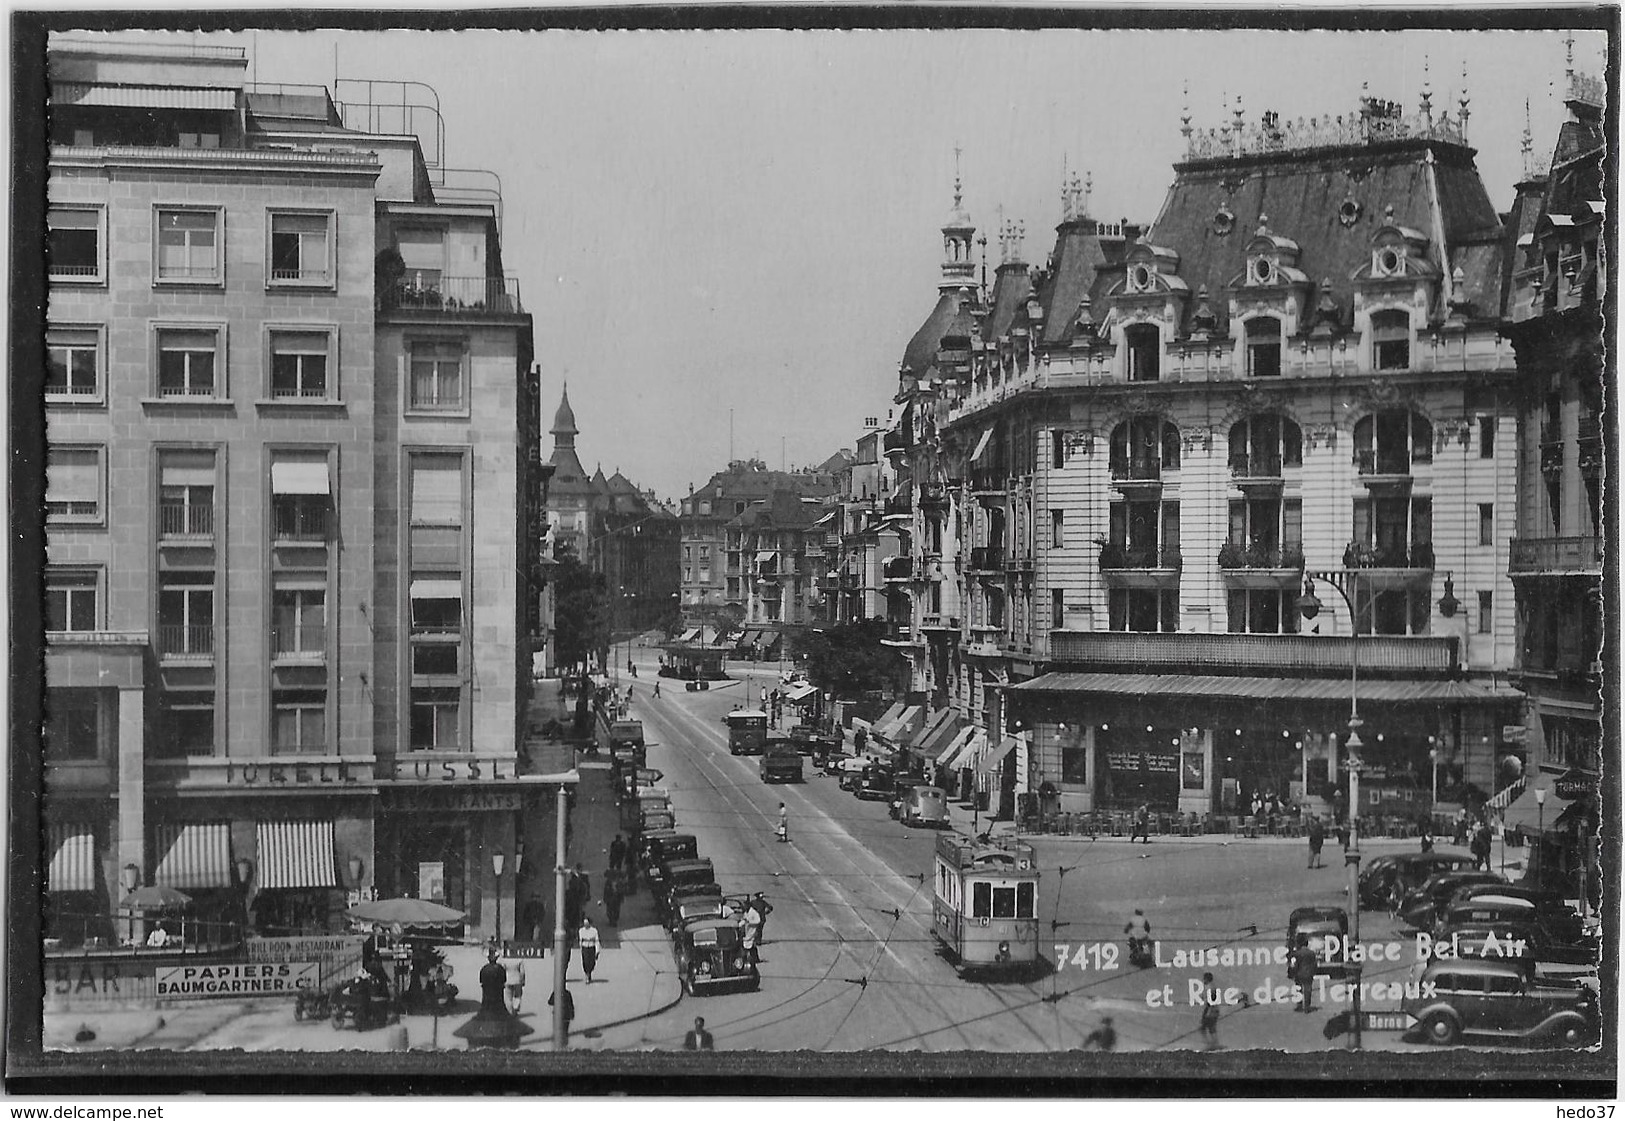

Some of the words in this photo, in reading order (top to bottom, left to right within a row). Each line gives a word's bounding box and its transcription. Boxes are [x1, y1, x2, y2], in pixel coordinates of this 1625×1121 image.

[1020, 859, 1028, 871] 3
[55, 963, 119, 994] BAR
[184, 964, 290, 979] PAPIERS
[157, 979, 284, 994] BAUMGARTNER
[1369, 1014, 1402, 1028] Berne
